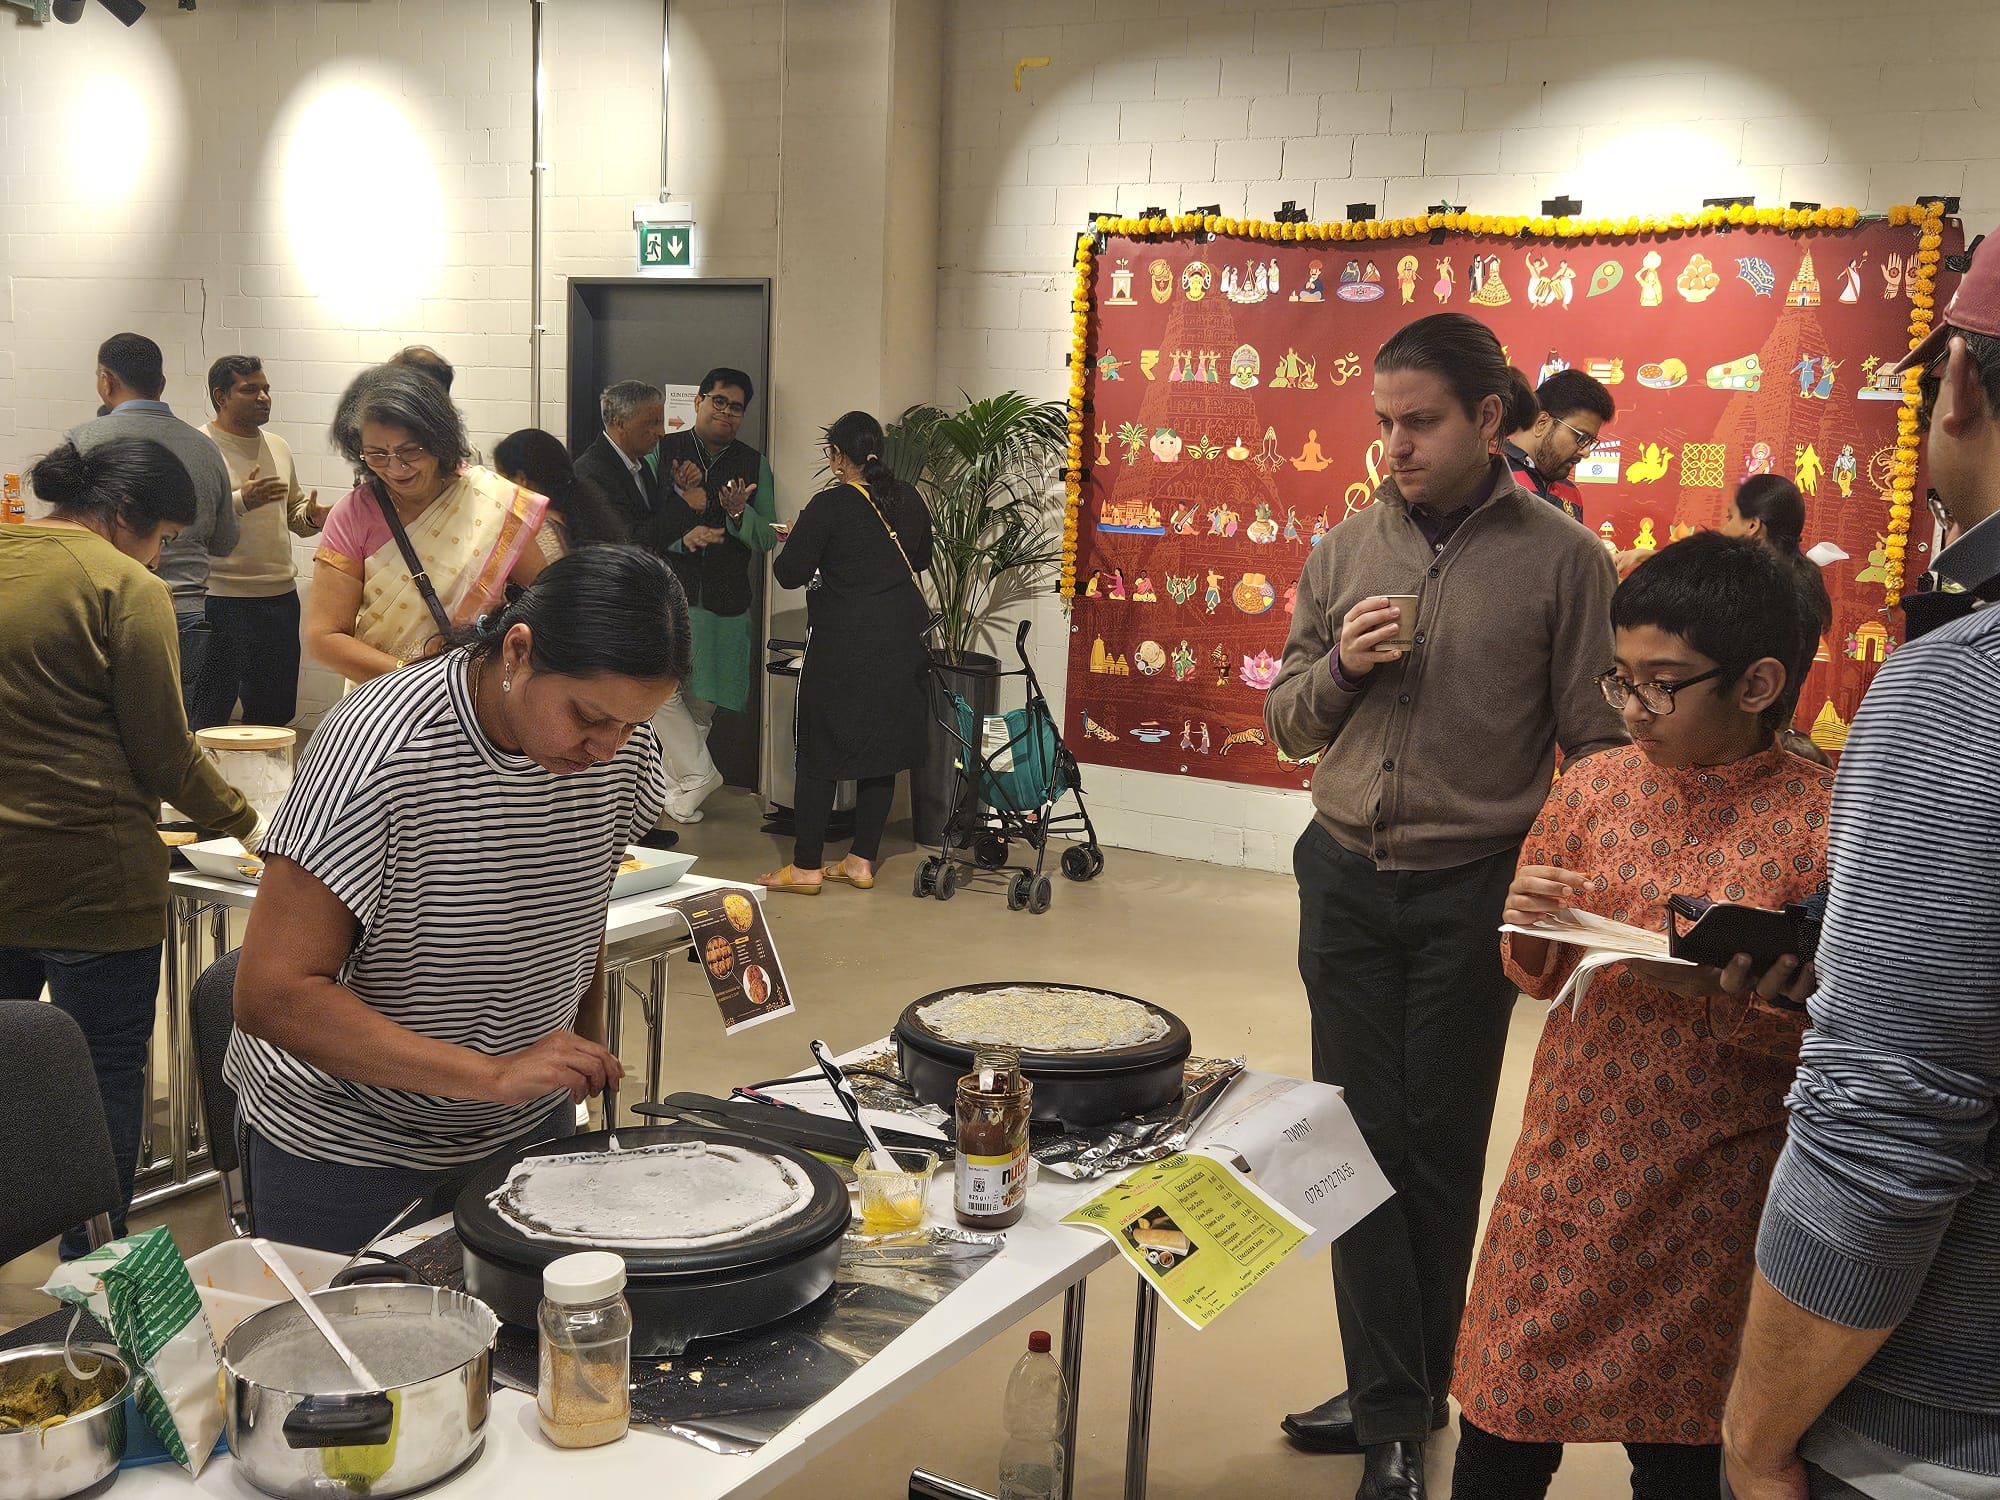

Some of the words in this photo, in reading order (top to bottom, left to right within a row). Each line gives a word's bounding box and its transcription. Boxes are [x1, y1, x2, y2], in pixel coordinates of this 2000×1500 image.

[1282, 1118, 1313, 1143] TWINT
[1304, 1184, 1324, 1204] 078
[1319, 1174, 1338, 1193] 712
[1332, 1168, 1347, 1185] 70
[1341, 1162, 1355, 1178] 55
[1237, 1246, 1255, 1260] Chocolate
